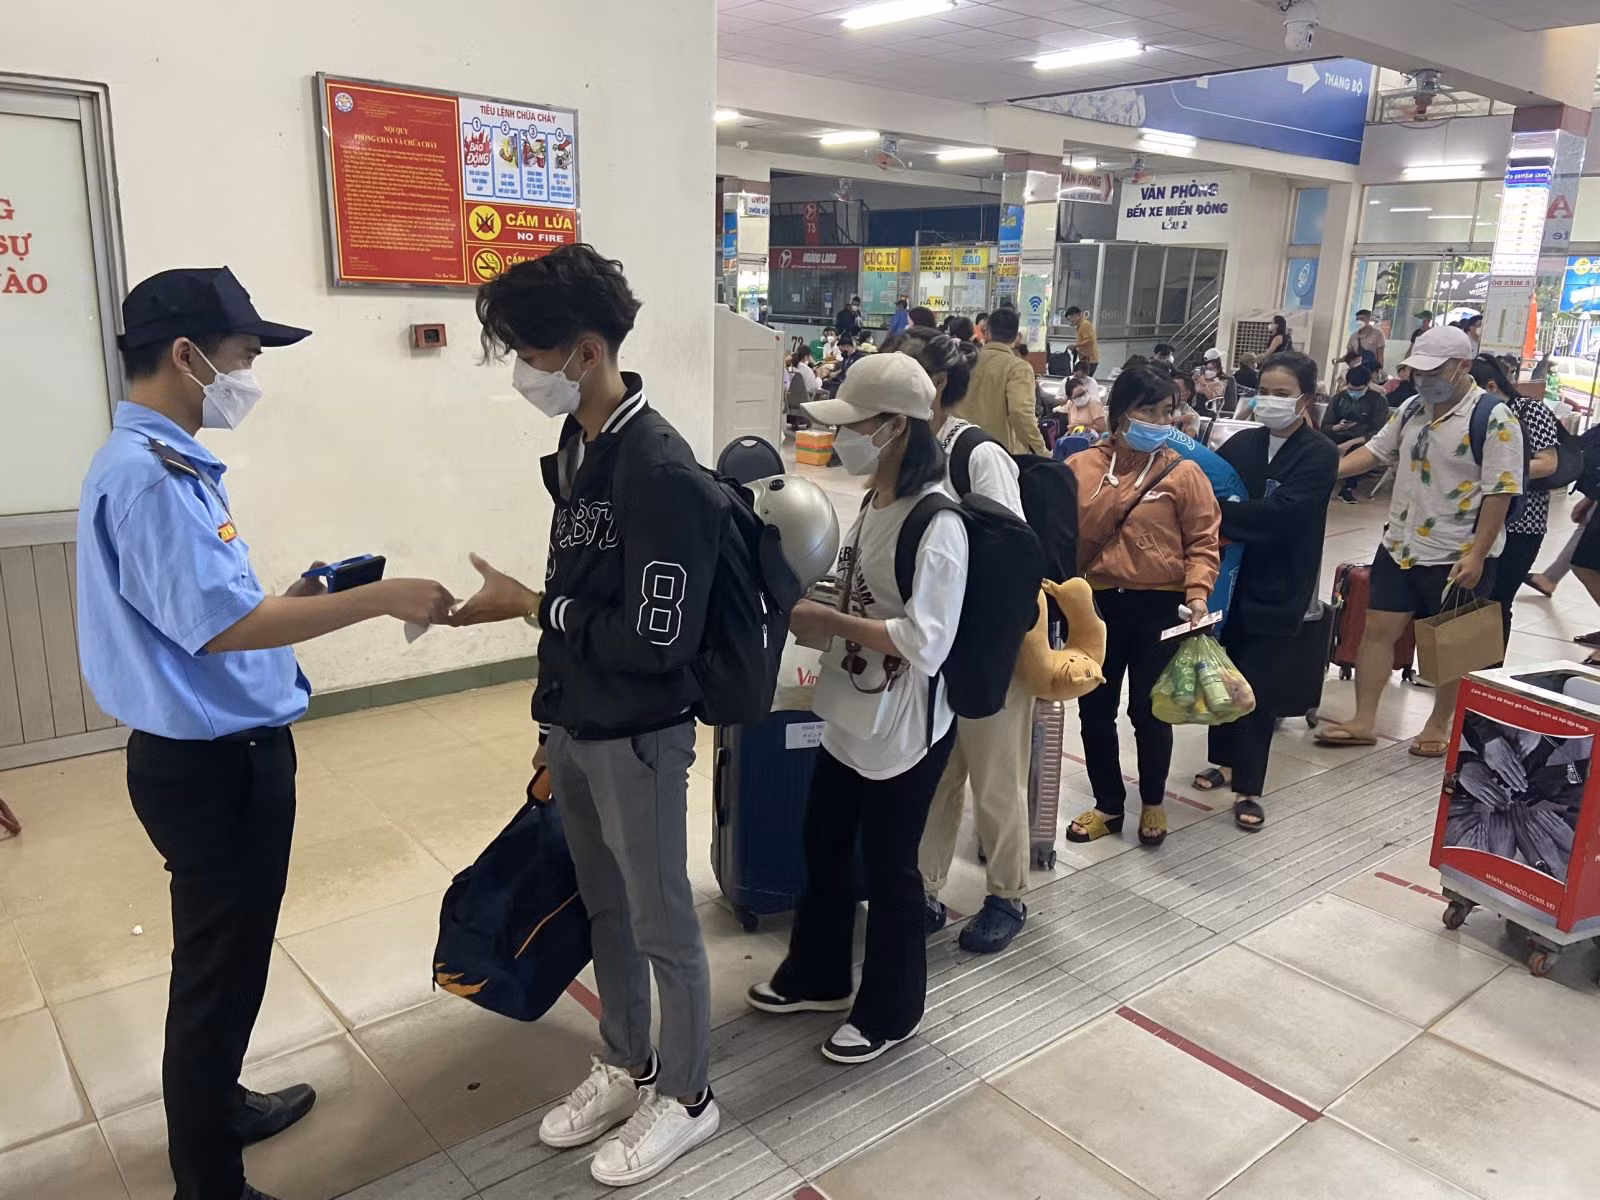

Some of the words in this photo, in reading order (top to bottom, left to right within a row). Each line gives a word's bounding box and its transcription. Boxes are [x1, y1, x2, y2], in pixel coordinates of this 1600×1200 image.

[1325, 72, 1350, 90] THANG
[1352, 78, 1362, 96] BỘ
[480, 104, 495, 116] TIÊU
[497, 106, 514, 120] LỆNH
[466, 151, 490, 166] ĐỘNG
[1141, 184, 1166, 200] VĂN
[1126, 203, 1146, 218] BẾN
[1148, 206, 1162, 217] XE
[1166, 200, 1192, 216] MIỀN
[1196, 202, 1228, 215] ĐÔNG
[506, 210, 538, 228] CẤM
[544, 213, 573, 230] LỬA
[806, 222, 816, 233] 73
[1182, 220, 1188, 230] 2
[517, 232, 534, 240] NO
[538, 234, 564, 242] FIRE
[0, 266, 48, 294] ÀO
[637, 561, 687, 646] 8
[1486, 872, 1556, 911] www.samco.com.vn
